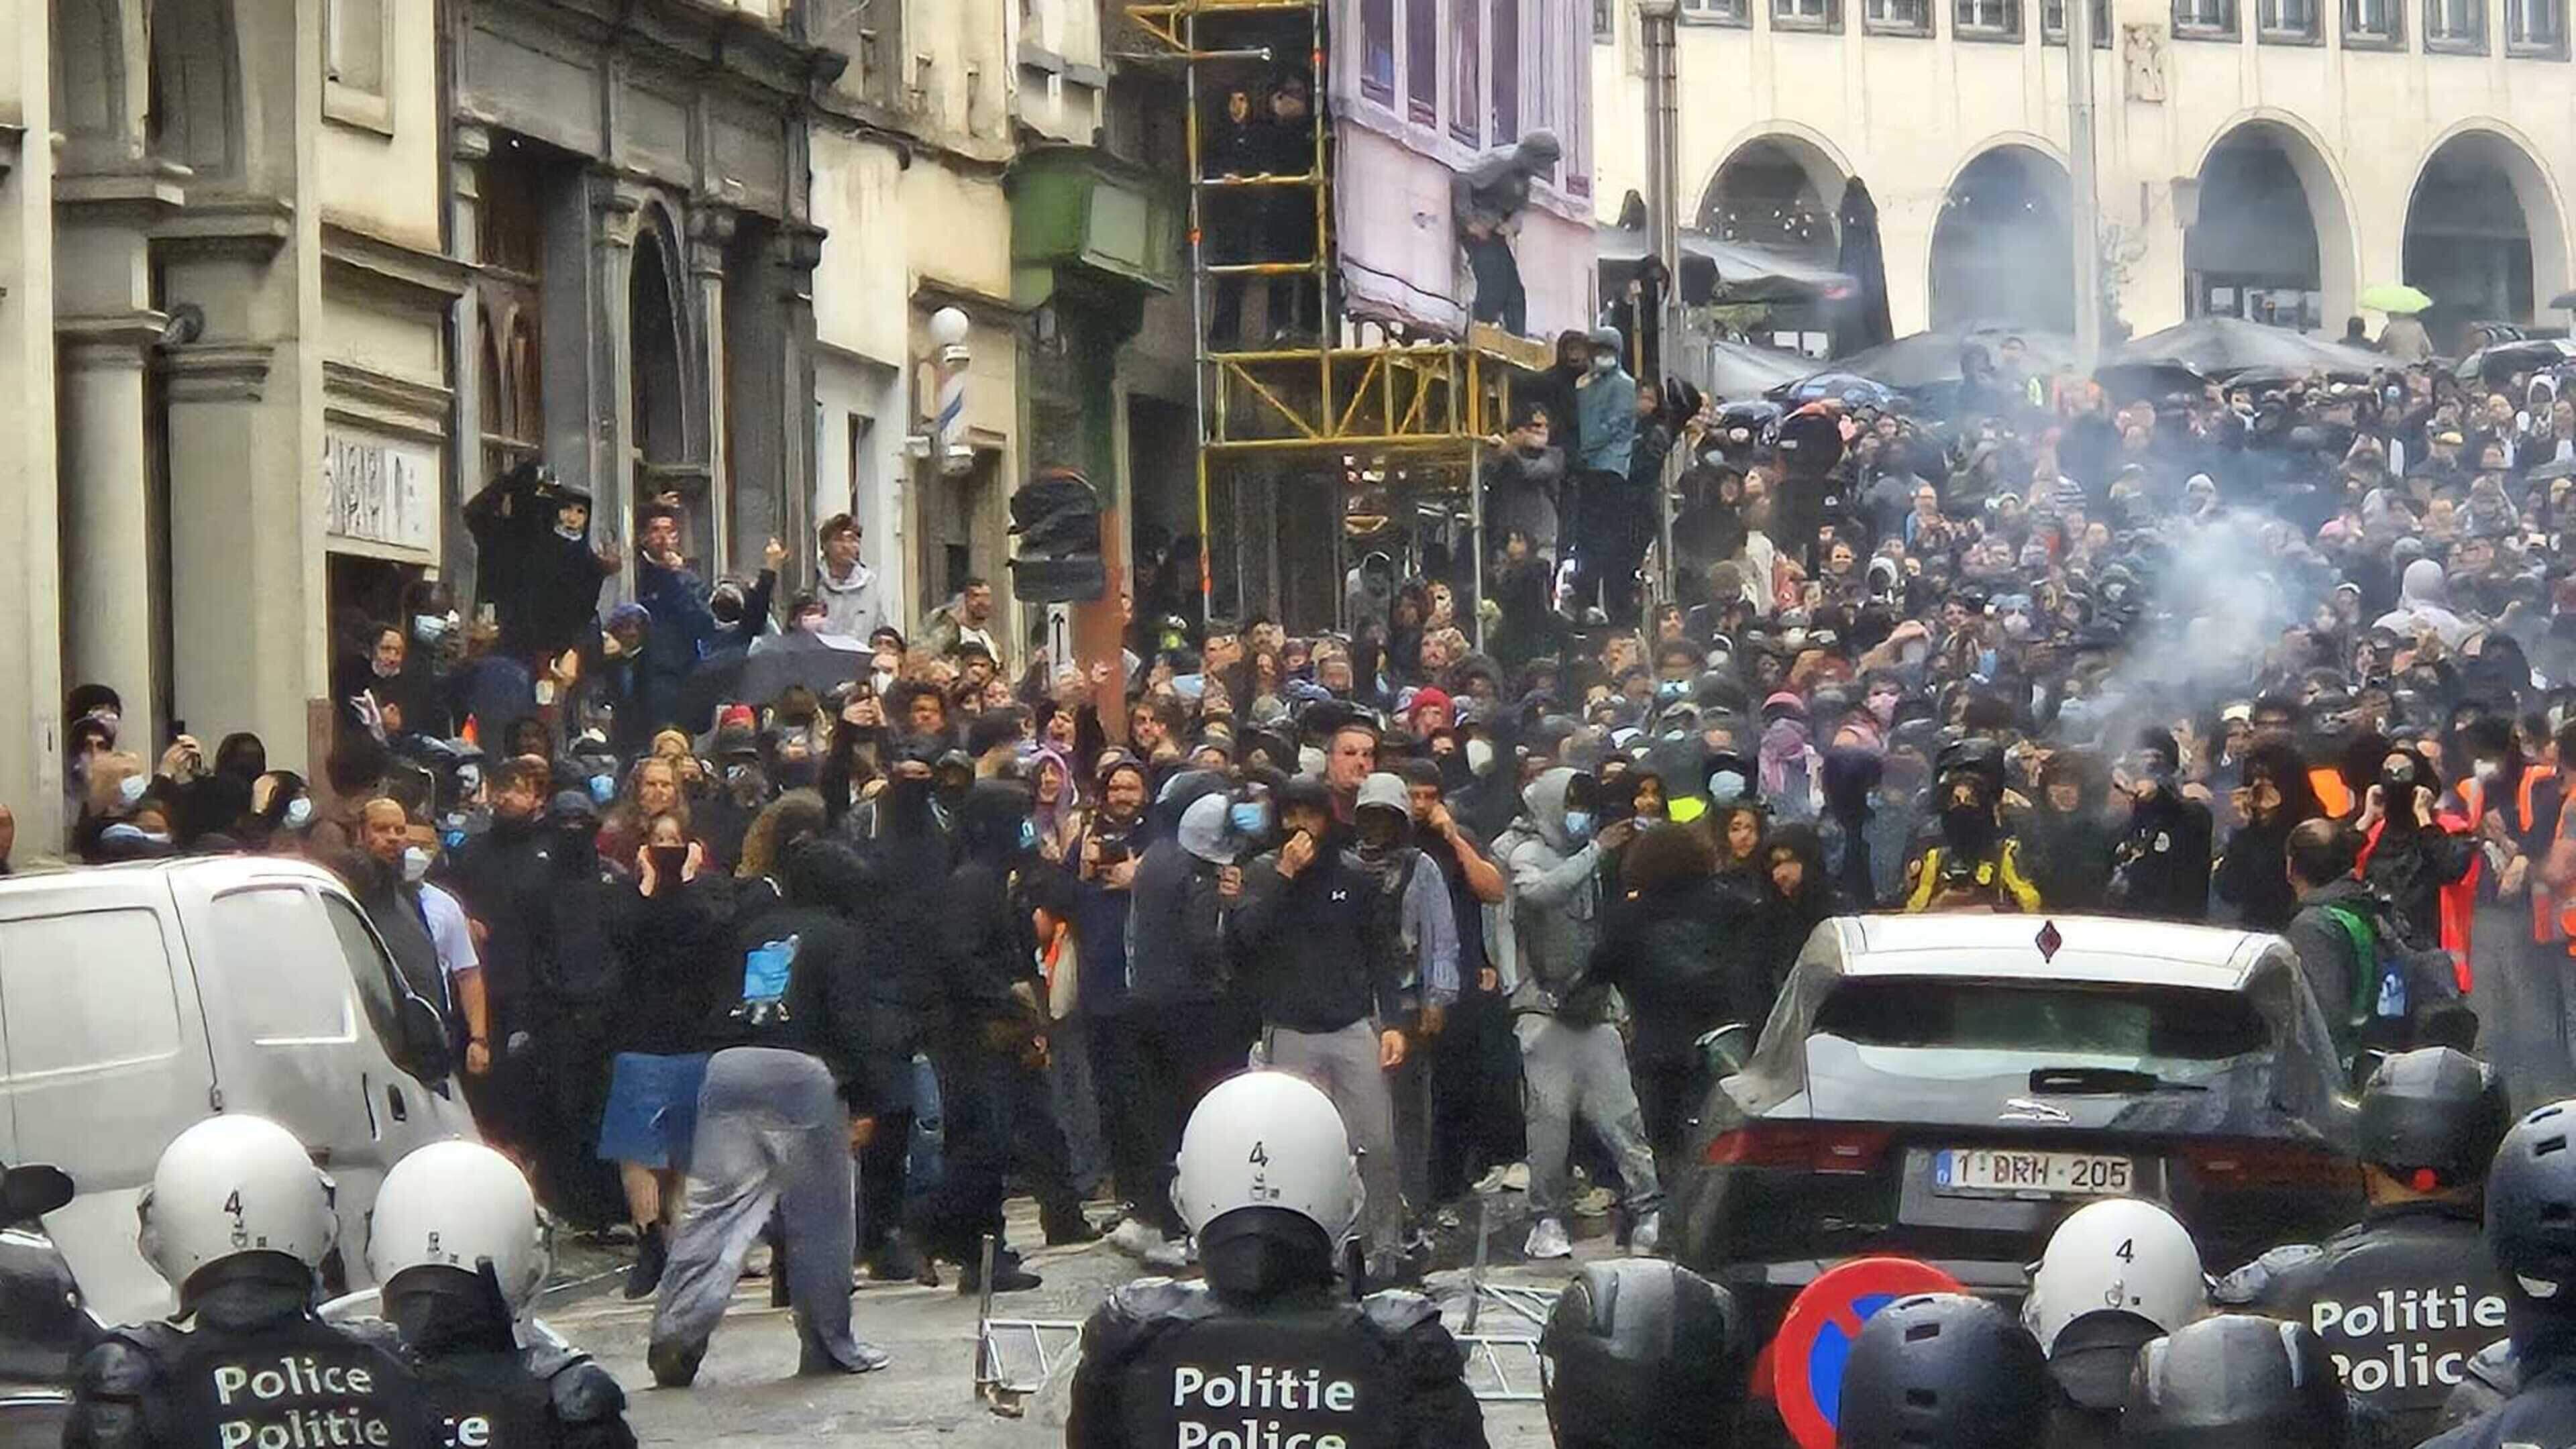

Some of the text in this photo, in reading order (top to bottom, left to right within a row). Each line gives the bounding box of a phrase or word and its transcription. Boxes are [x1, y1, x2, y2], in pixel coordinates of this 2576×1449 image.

[1249, 1141, 1268, 1167] 4
[224, 1189, 242, 1217] 4
[2116, 1238, 2133, 1263] 4
[2312, 1285, 2508, 1337] Politie
[214, 1356, 373, 1405] Police
[1175, 1365, 1355, 1411] Politie
[220, 1407, 389, 1449] Politie
